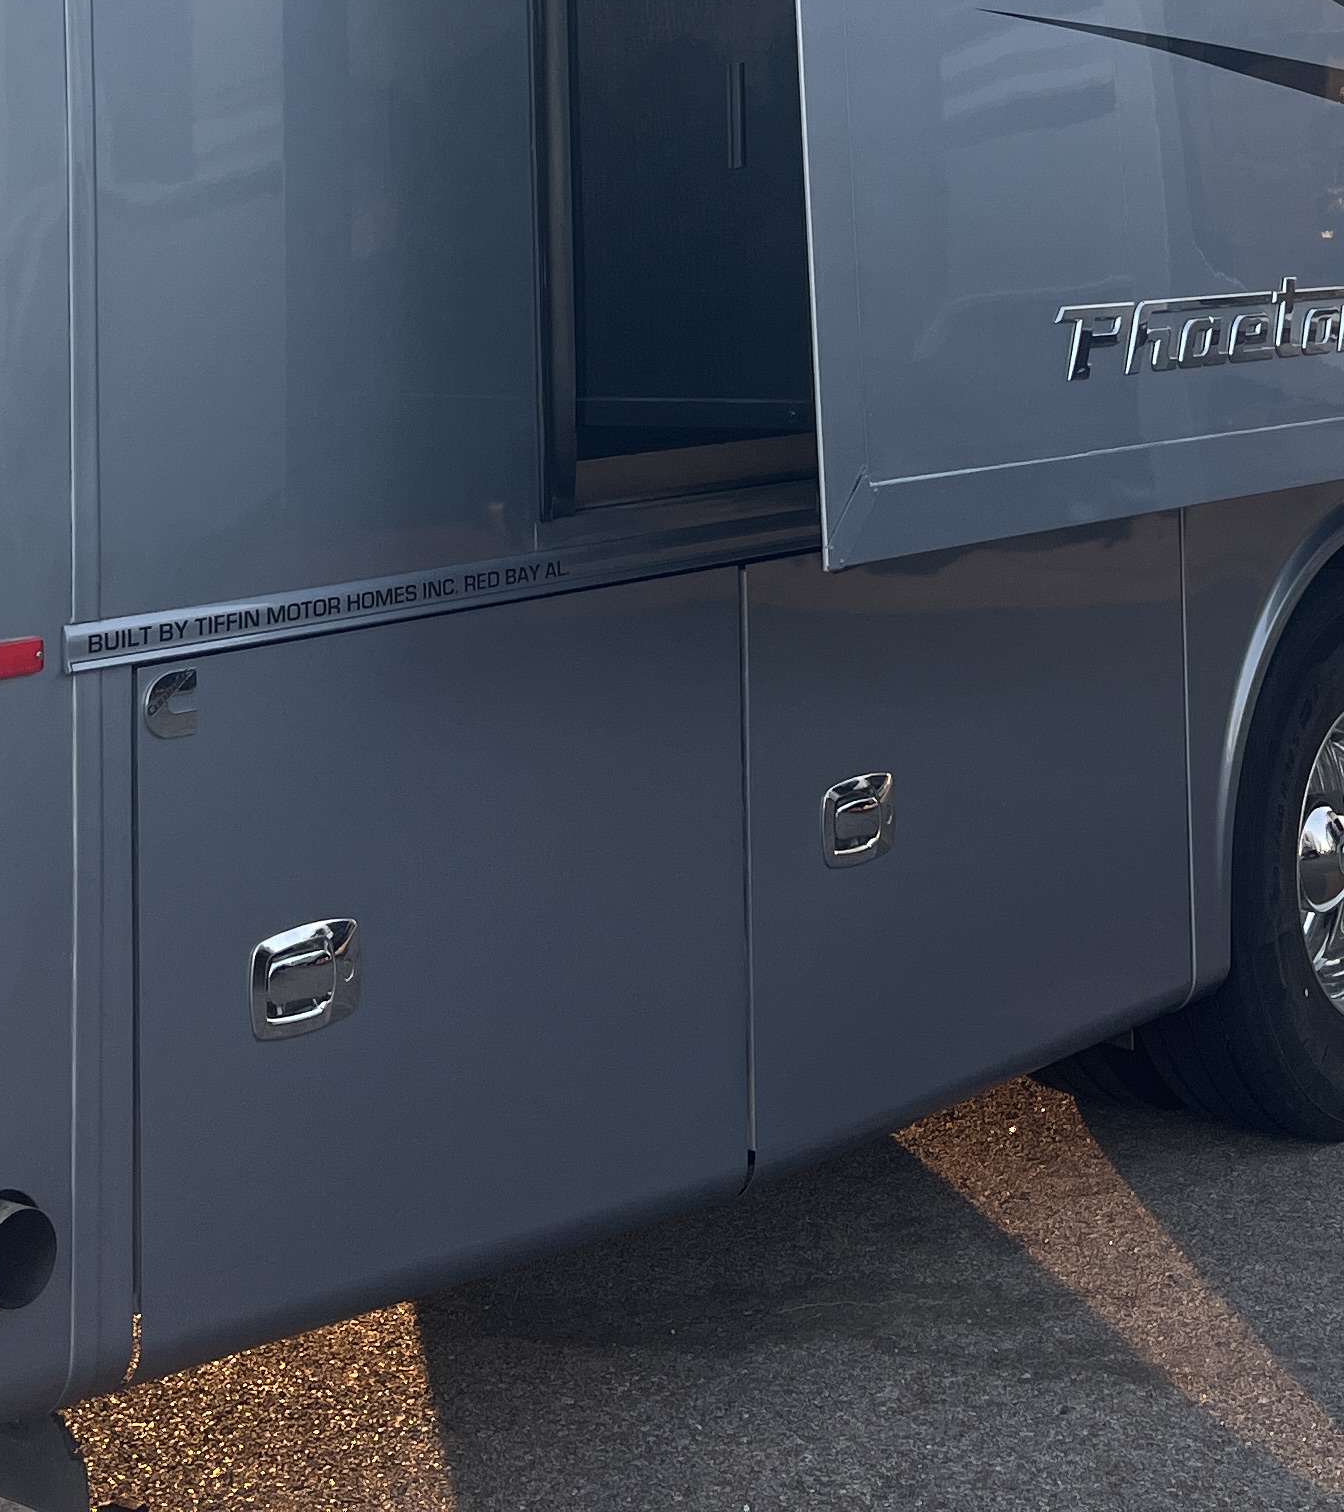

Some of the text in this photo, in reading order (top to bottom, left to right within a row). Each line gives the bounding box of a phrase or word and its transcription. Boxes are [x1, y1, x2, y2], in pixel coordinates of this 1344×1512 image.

[87, 625, 153, 654] BUILT
[159, 619, 190, 643] BY
[195, 607, 260, 637] TIFFIN
[266, 596, 342, 625] MOTOR
[347, 584, 418, 613] HOMES
[464, 570, 500, 592] RED
[505, 564, 541, 585] BAY
